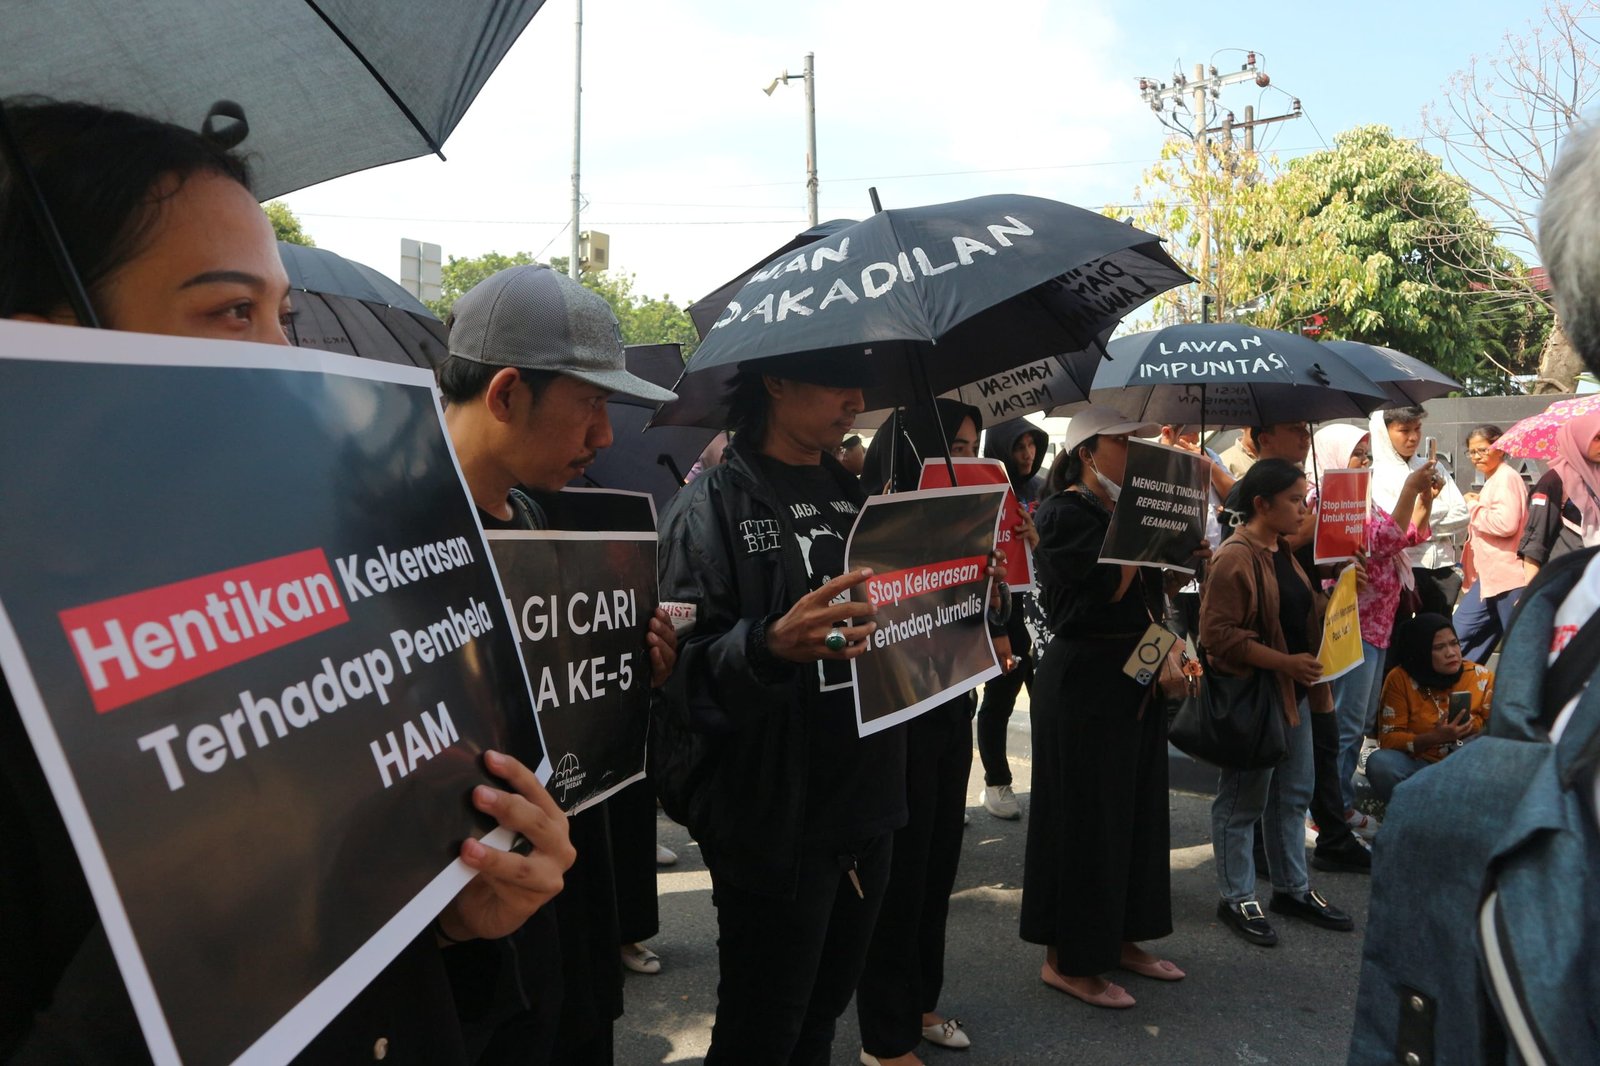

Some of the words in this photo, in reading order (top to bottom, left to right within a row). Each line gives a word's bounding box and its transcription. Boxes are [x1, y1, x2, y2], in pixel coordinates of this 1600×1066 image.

[1159, 335, 1262, 355] LAWAN
[1131, 476, 1176, 495] MENGUTUK
[790, 503, 821, 519] JAGA
[1136, 496, 1172, 513] REPRESIF
[1172, 503, 1200, 517] APARAT
[1322, 500, 1340, 512] Stop
[1322, 512, 1345, 523] Untuk
[1141, 515, 1188, 532] KEAMANAN
[869, 580, 902, 606] Stop
[904, 563, 979, 596] Kekerasan
[71, 567, 340, 690] Hentikan
[335, 534, 474, 602] Kekerasan
[567, 588, 637, 636] CARI
[934, 595, 982, 628] Jurnalis
[567, 652, 633, 704] KE-5
[137, 645, 394, 792] Terhadap
[390, 597, 494, 676] Pembela
[369, 701, 460, 789] HAM
